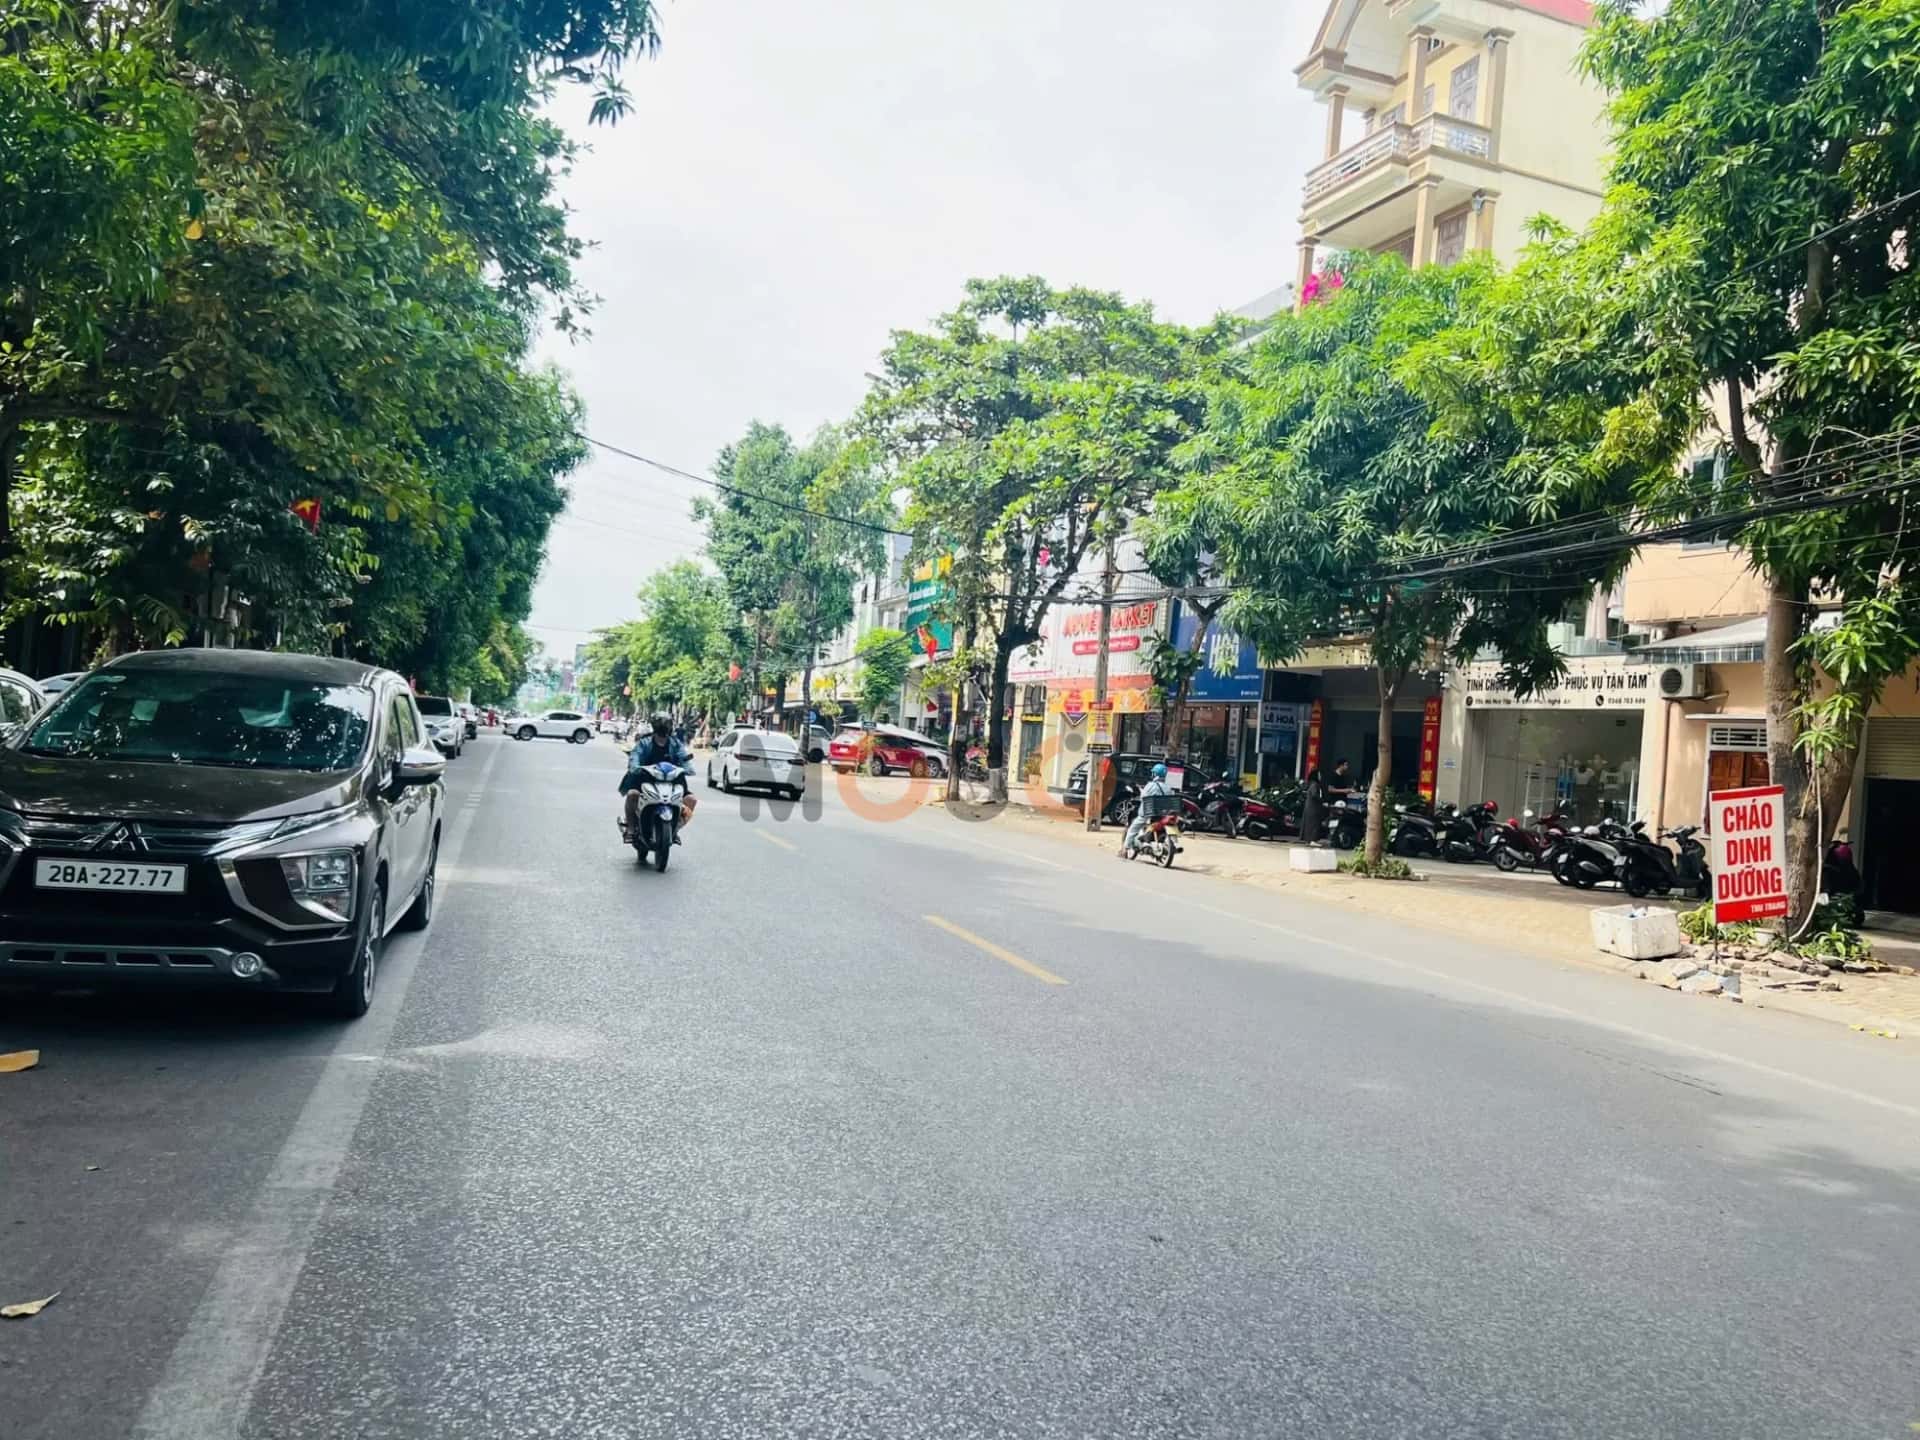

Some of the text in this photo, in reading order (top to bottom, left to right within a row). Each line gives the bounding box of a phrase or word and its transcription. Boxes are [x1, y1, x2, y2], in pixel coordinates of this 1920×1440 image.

[1607, 672, 1625, 693] TẬN
[1628, 671, 1647, 690] TÂM
[1723, 799, 1773, 832] CHÁO
[1726, 836, 1772, 866] DINH
[47, 865, 173, 887] 28A-227.77
[1718, 865, 1782, 901] DƯỠNG
